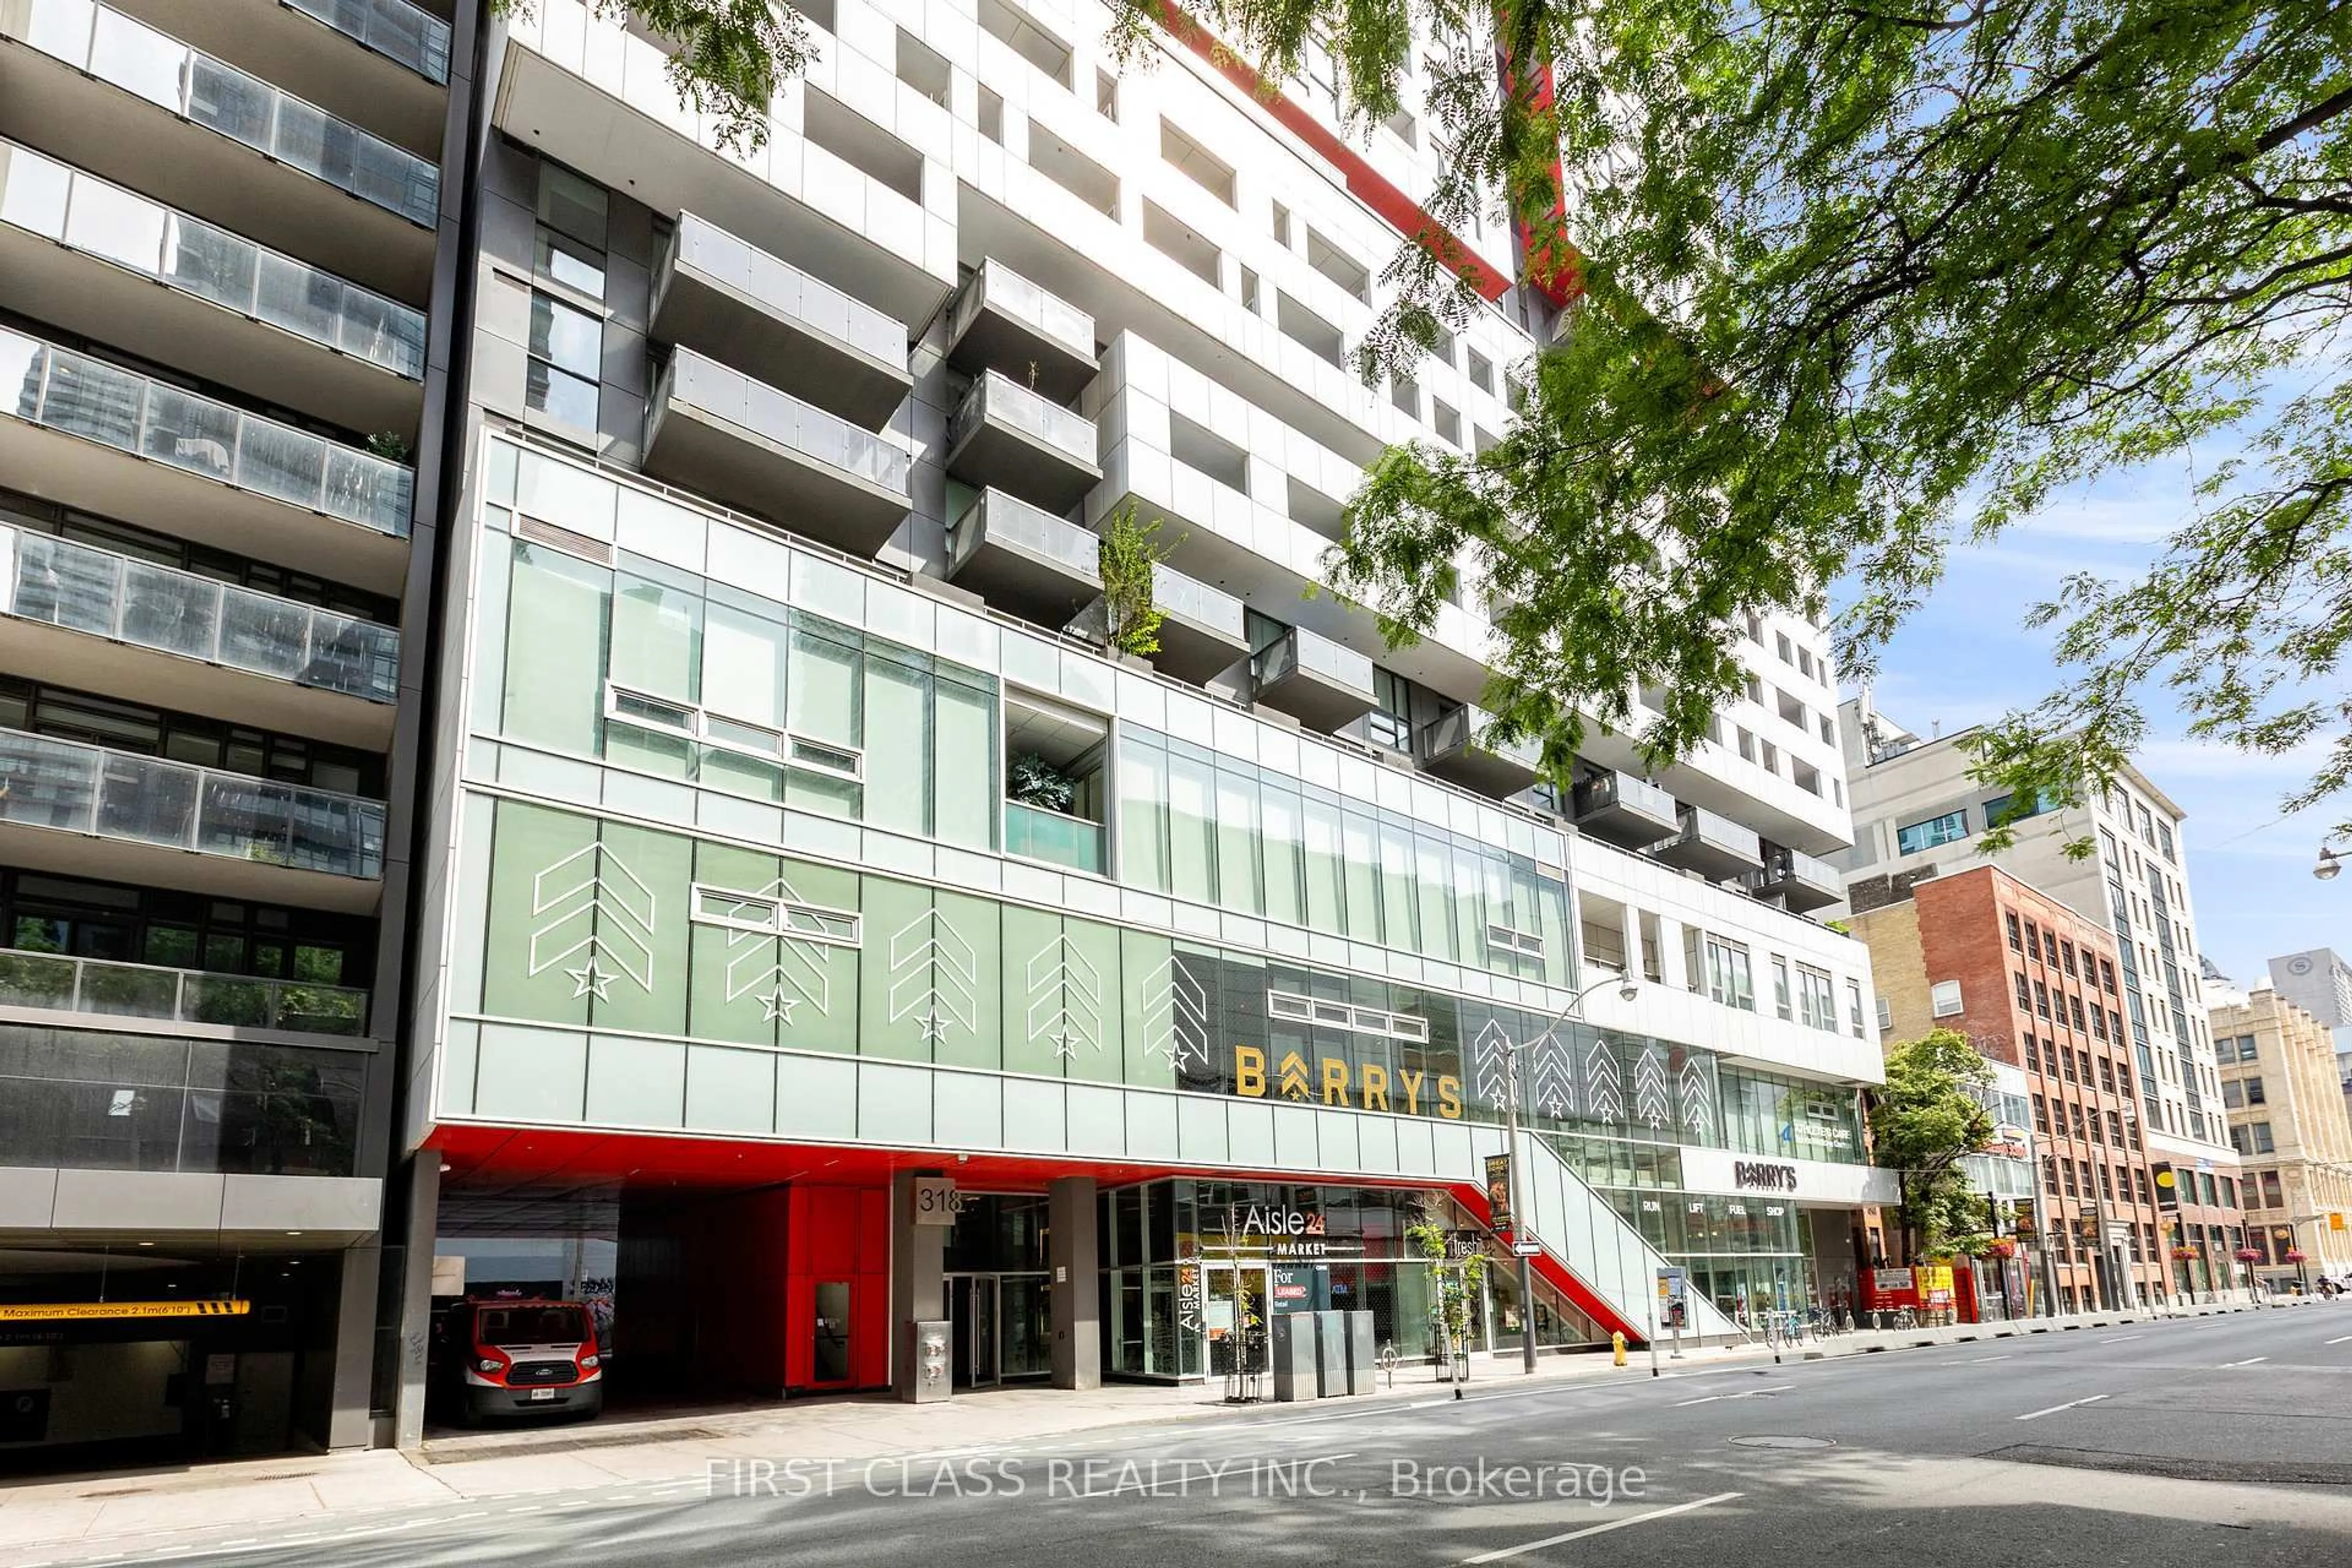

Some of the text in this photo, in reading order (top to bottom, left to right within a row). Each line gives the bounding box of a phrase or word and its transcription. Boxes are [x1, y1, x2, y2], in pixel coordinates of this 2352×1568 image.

[920, 1188, 962, 1212] 318
[1643, 1200, 1785, 1216] RUN LIFT FUEL SHOP
[1276, 1242, 1325, 1256] MARKET
[1273, 1268, 1294, 1284] For
[3, 1308, 64, 1317] Maximum
[67, 1306, 129, 1316] Clearance
